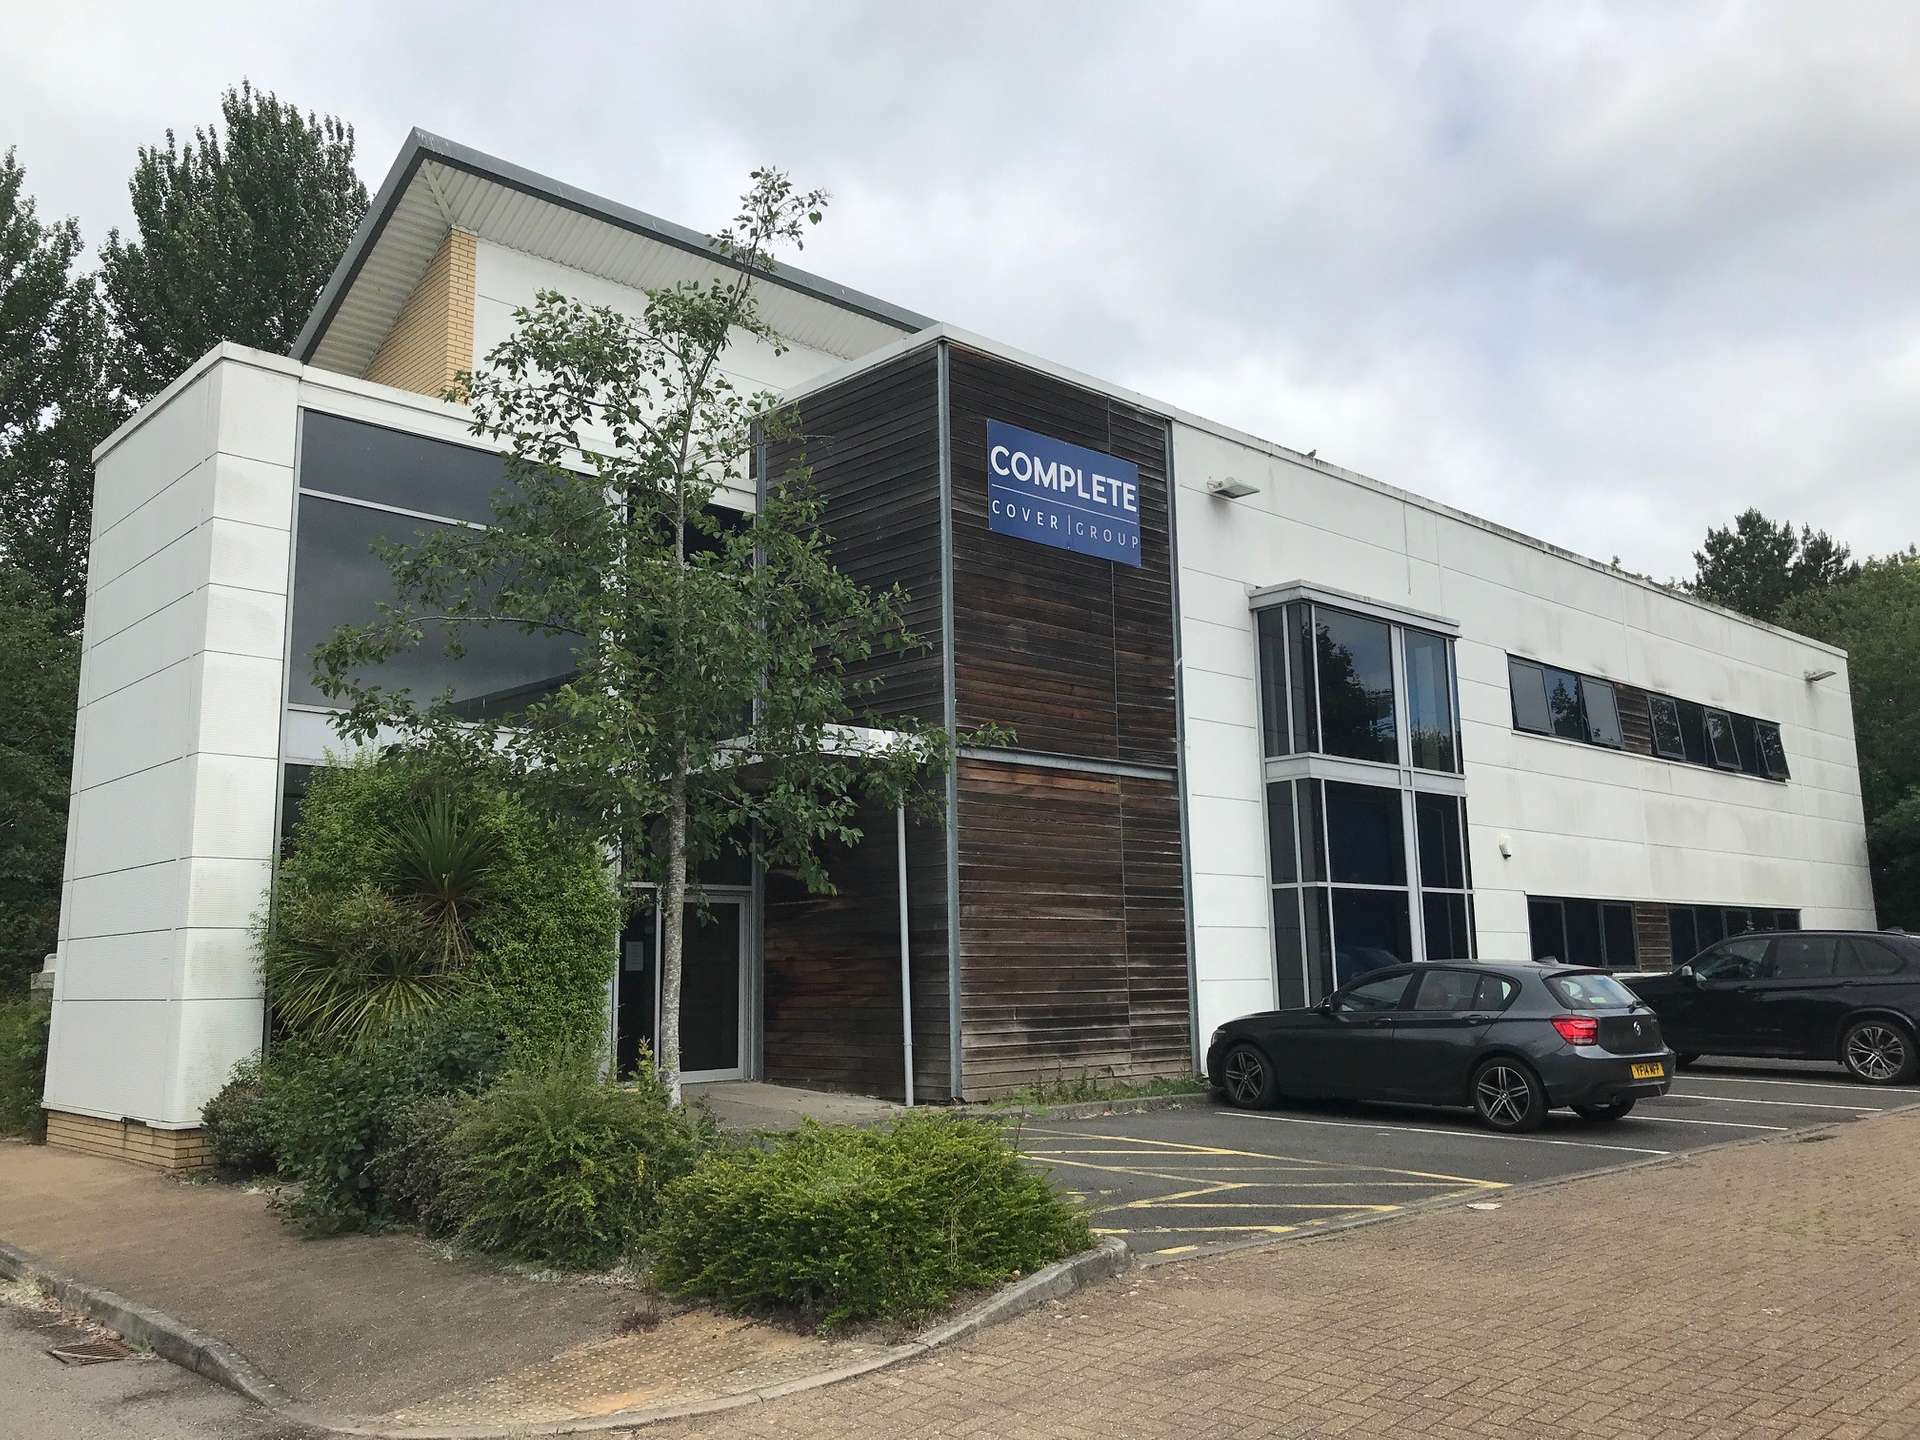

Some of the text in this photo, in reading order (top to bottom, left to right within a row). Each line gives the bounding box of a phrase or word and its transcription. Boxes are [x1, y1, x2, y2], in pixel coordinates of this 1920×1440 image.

[990, 445, 1137, 512] COMPLETE
[992, 500, 1139, 549] COVER GROUP
